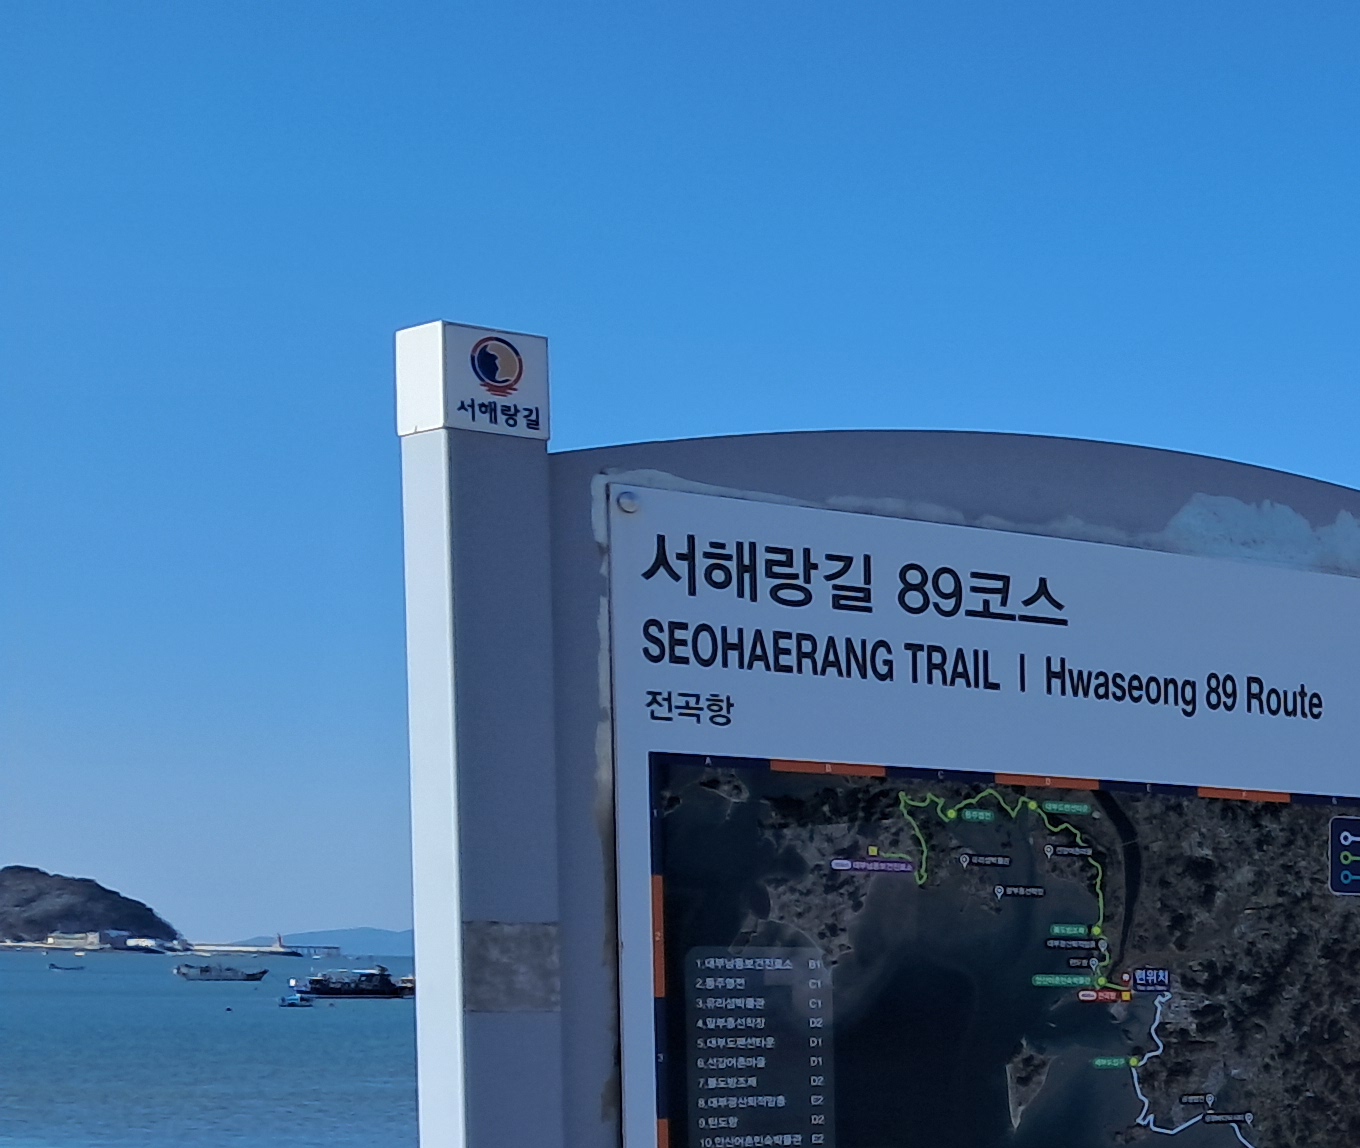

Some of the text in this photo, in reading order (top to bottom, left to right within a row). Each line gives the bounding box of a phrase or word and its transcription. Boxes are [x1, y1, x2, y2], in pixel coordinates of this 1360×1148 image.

[456, 398, 541, 430] 서해랑길
[641, 534, 1069, 627] 서해랑길 89코스
[642, 619, 1323, 720] SEOHAERANG TRAIL Hwaseong 89 Route
[645, 689, 735, 727] 전곡항
[1136, 969, 1169, 985] 현위치
[808, 979, 822, 989] C1
[809, 998, 822, 1009] C1
[809, 1018, 823, 1028] D2
[809, 1037, 822, 1047] D1
[810, 1056, 823, 1067] D1
[810, 1076, 824, 1086] D2
[811, 1114, 825, 1125] D2
